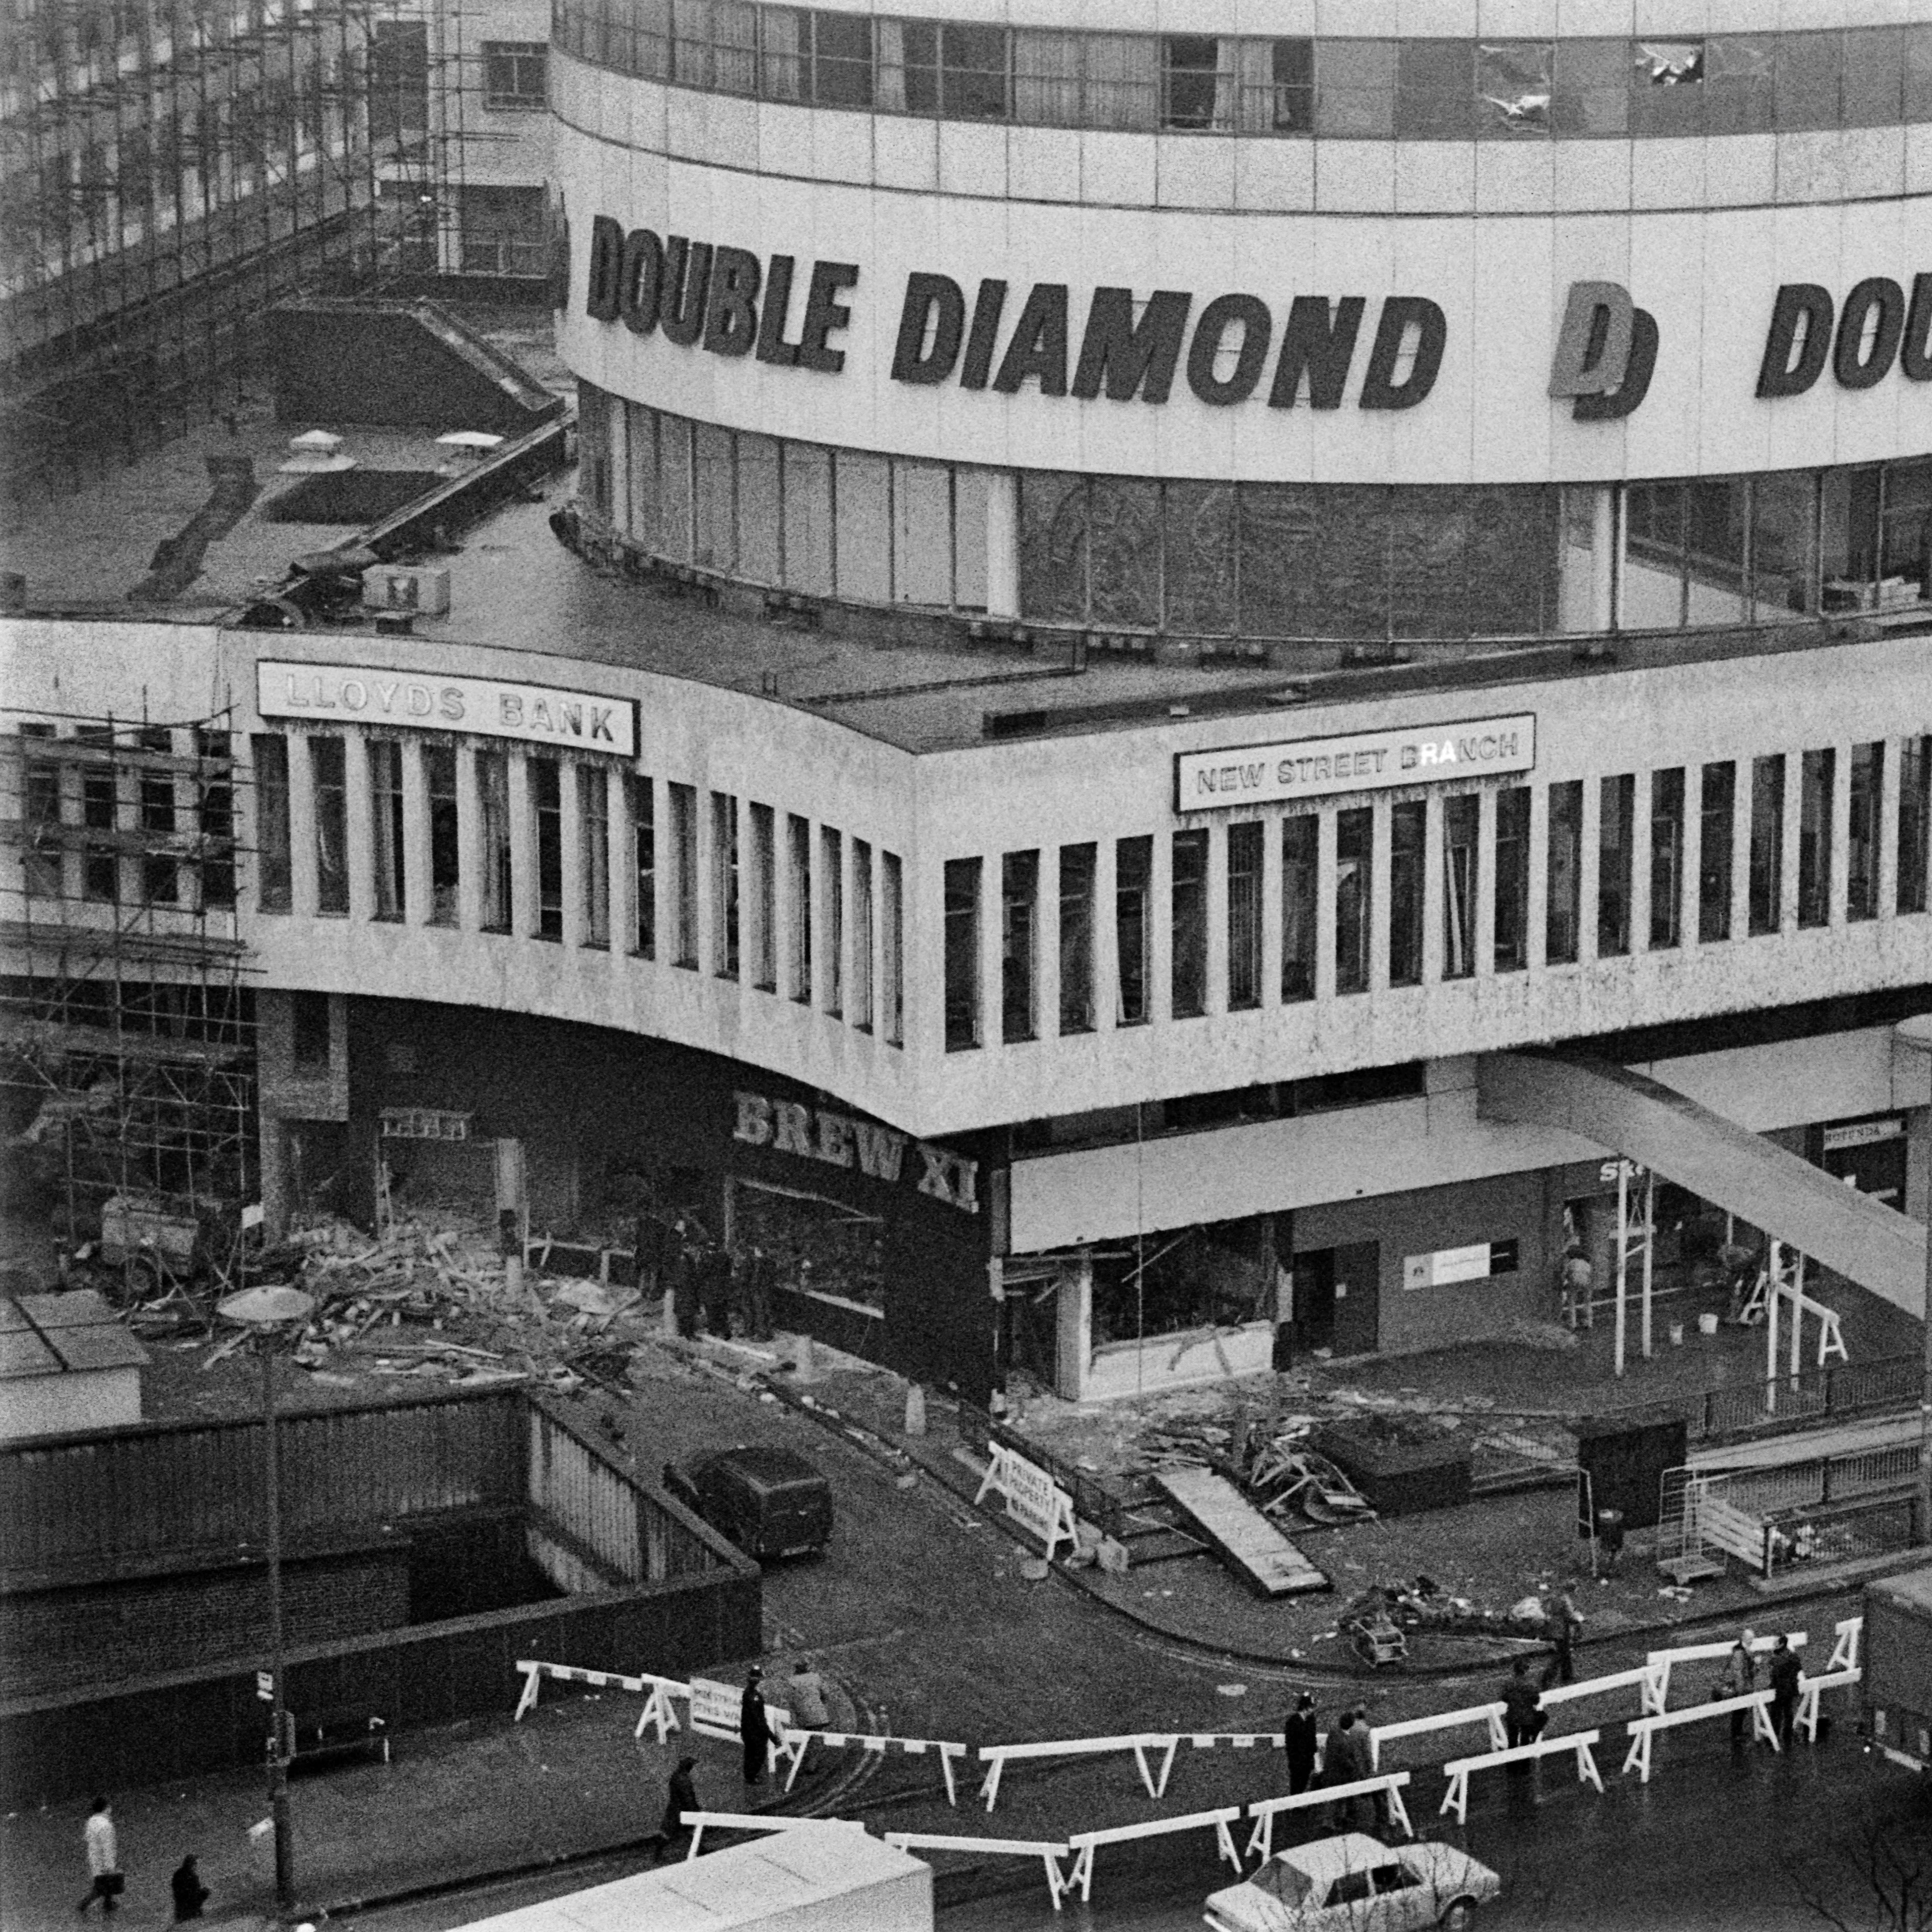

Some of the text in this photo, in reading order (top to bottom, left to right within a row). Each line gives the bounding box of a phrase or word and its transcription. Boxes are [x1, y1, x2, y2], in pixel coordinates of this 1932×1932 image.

[587, 214, 1446, 409] DOUBLE DIAMOND
[286, 674, 614, 742] LLOYDS BANK
[1198, 733, 1518, 794] NEW STREET BRANCH
